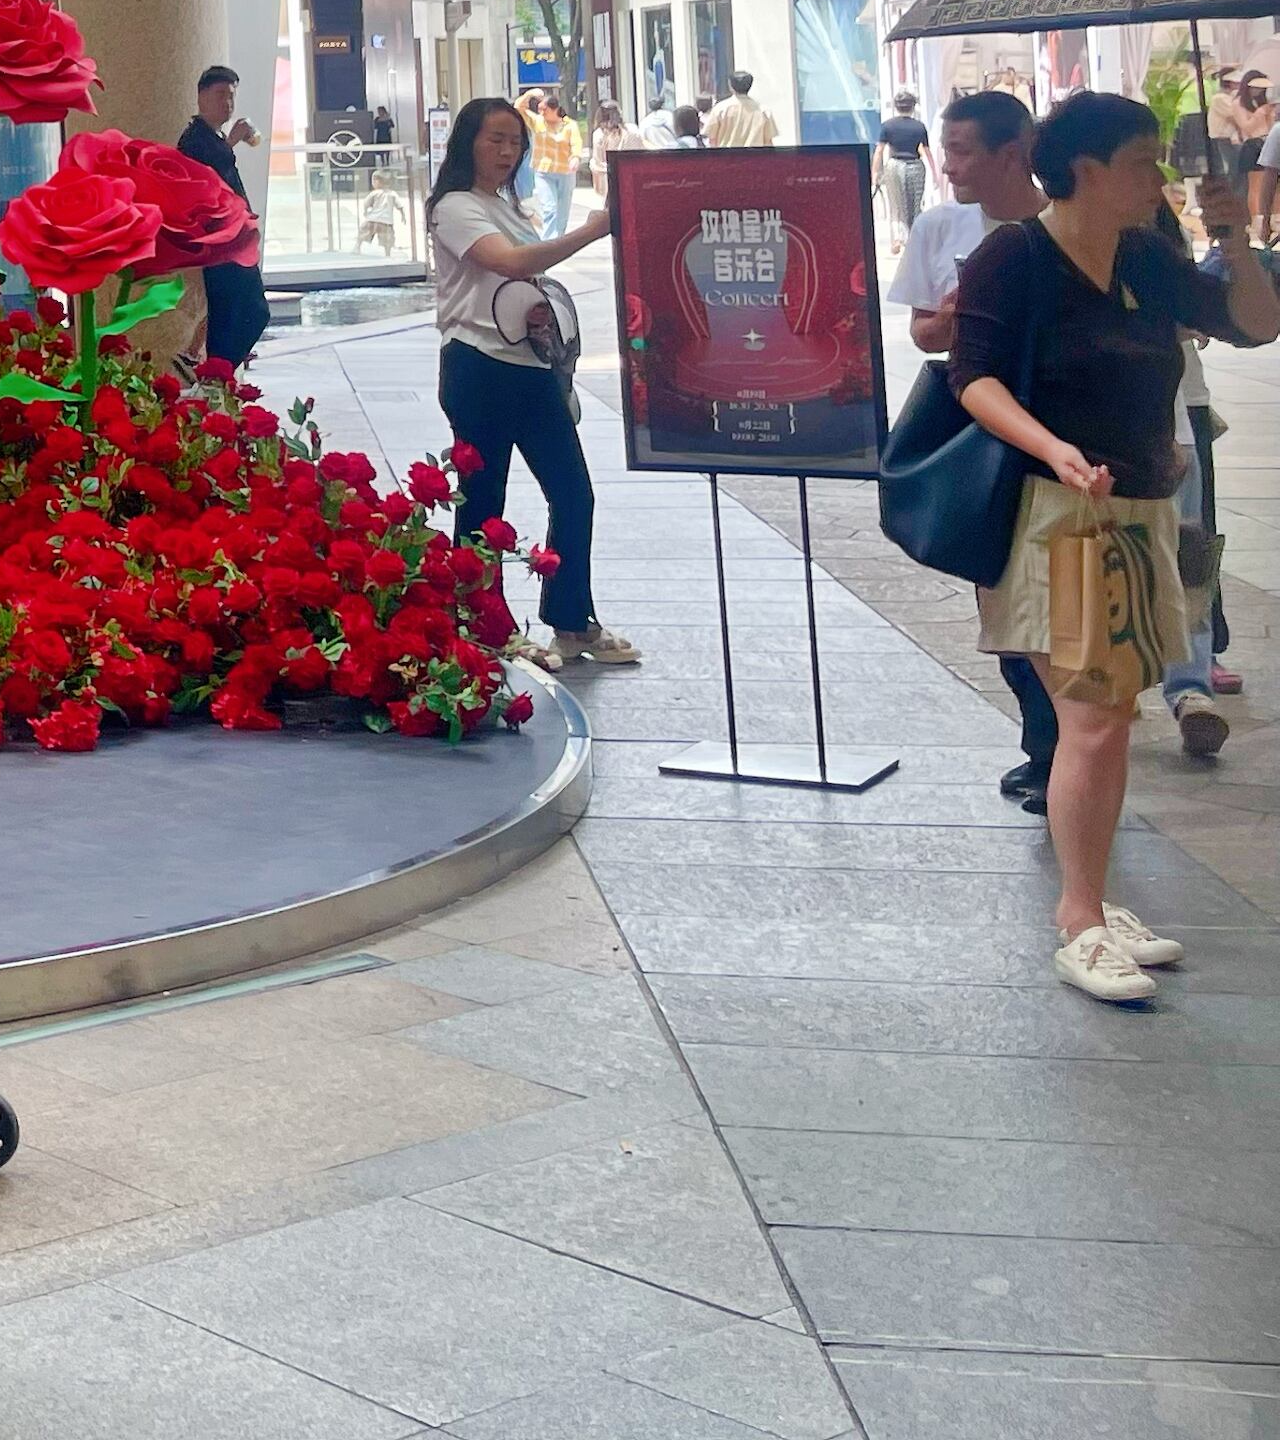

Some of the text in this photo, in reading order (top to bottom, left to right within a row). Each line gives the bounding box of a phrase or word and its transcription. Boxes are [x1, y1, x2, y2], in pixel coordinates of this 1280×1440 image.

[700, 209, 784, 244] 玫瑰星光
[714, 247, 776, 283] 音乐会
[703, 289, 790, 307] Concert
